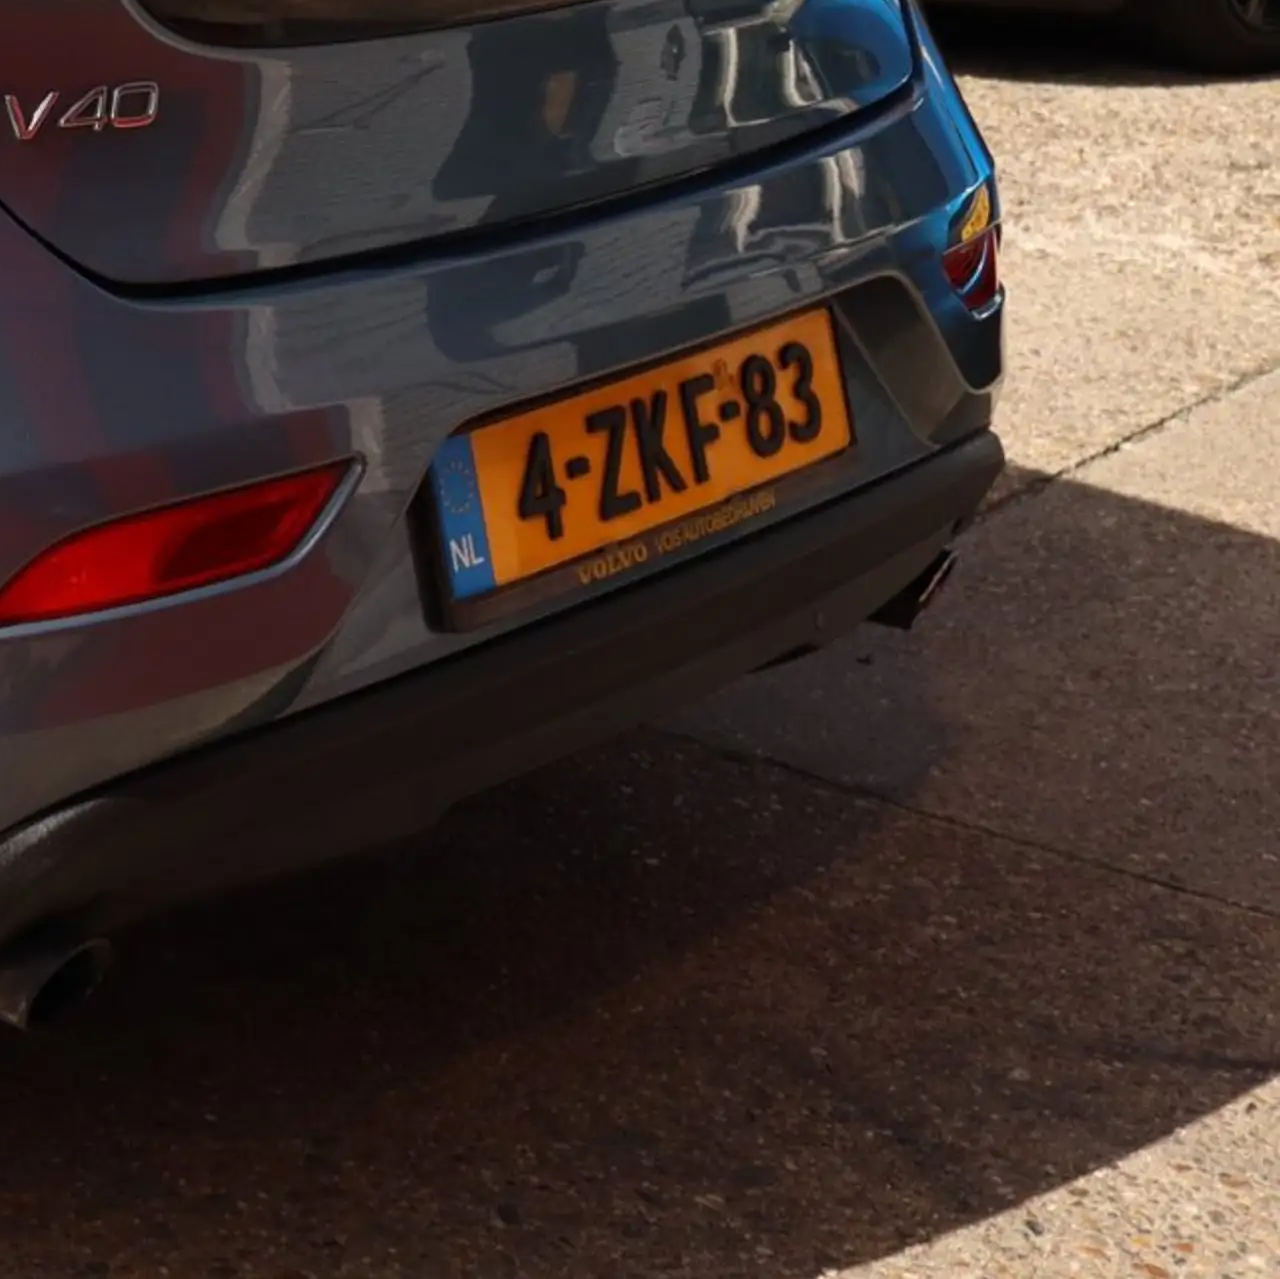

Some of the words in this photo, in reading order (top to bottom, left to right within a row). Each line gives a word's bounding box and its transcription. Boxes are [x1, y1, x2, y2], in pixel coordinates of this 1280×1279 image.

[4, 81, 159, 140] V40
[517, 341, 823, 542] 4-ZKF-83
[448, 533, 486, 572] NL
[578, 543, 648, 586] VOLVO
